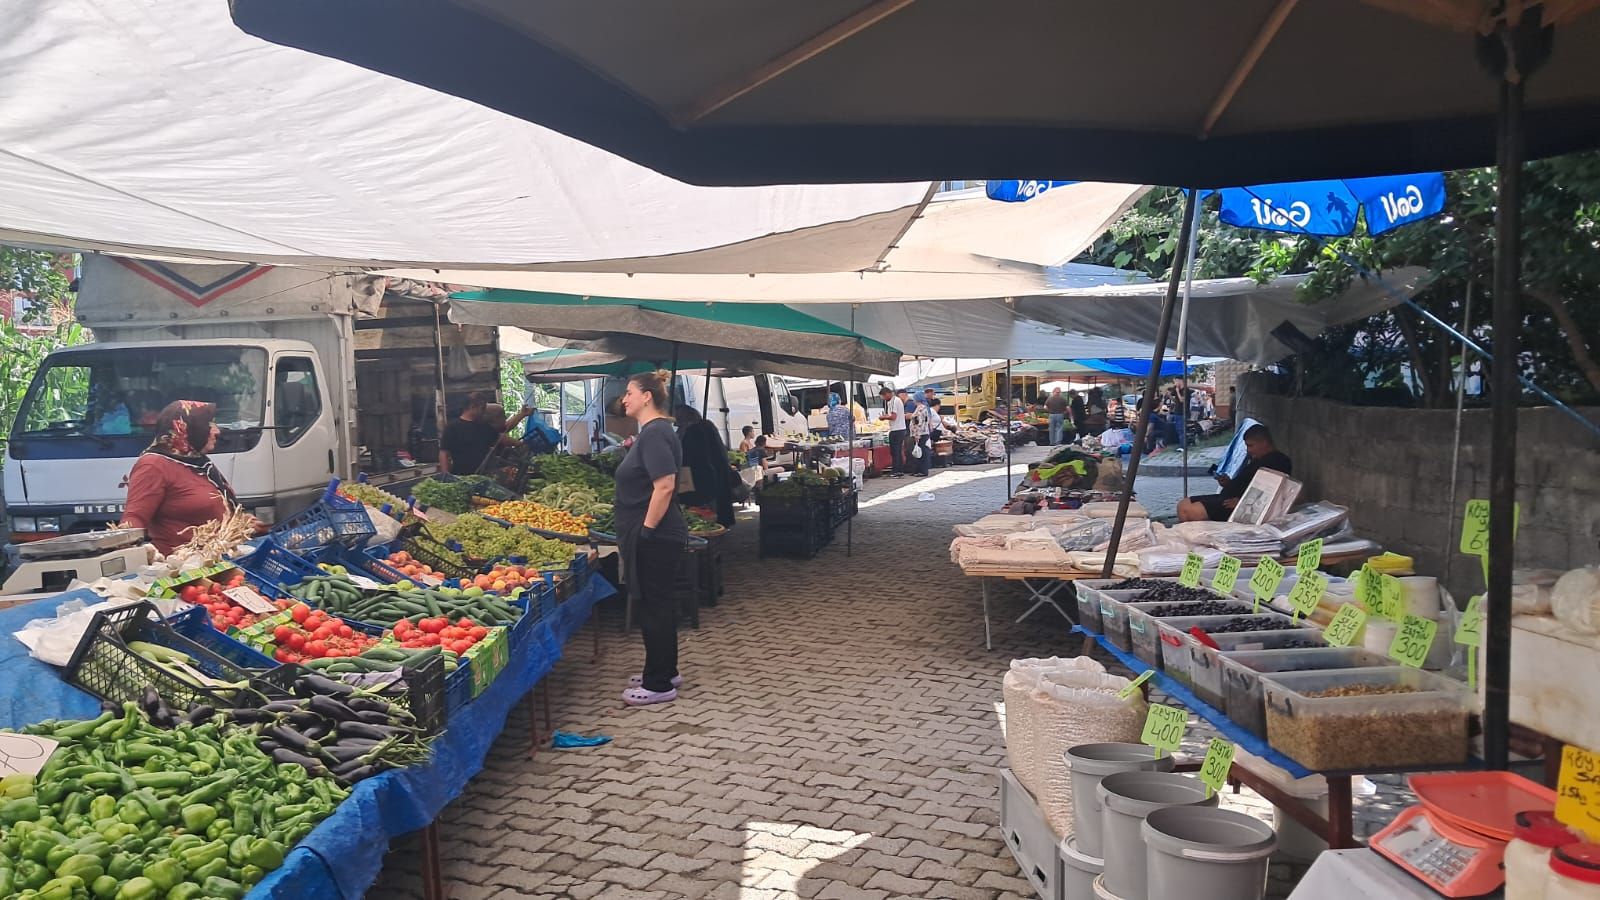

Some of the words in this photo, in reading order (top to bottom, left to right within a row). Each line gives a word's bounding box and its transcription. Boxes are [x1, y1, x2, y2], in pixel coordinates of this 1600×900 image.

[1217, 571, 1234, 588] 200
[1253, 567, 1274, 592] 200
[1294, 587, 1318, 609] 250
[1329, 623, 1353, 646] 300
[1396, 636, 1427, 661] 300
[1150, 721, 1180, 744] 400
[1206, 756, 1227, 783] 300
